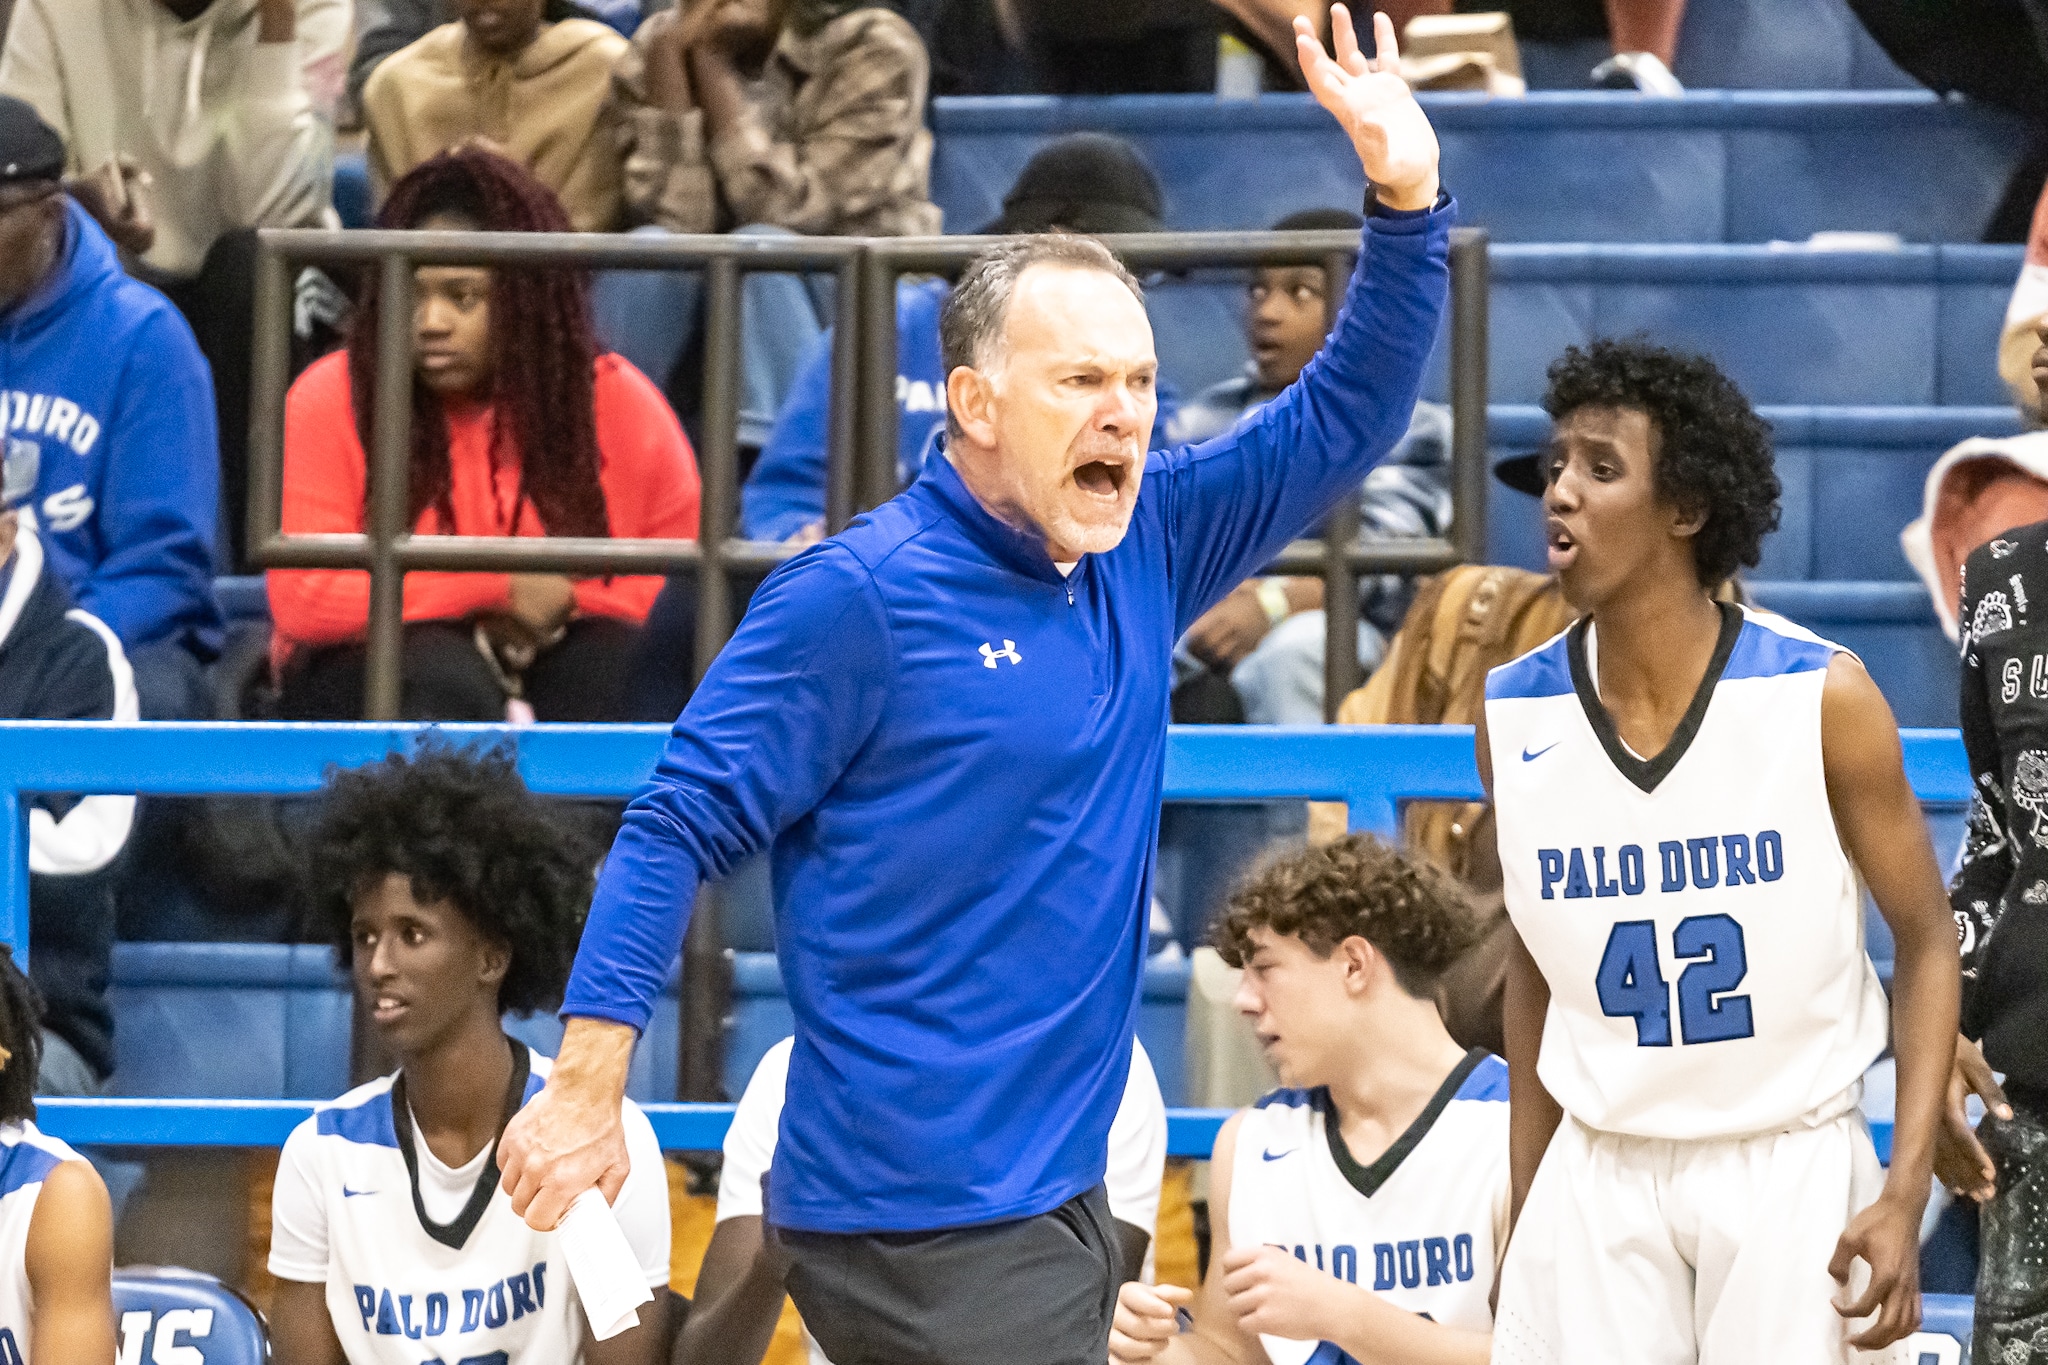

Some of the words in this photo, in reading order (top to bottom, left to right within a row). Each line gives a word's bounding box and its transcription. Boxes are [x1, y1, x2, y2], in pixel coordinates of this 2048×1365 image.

[1538, 844, 1645, 900] PALO
[1658, 830, 1784, 893] DURO
[1595, 913, 1755, 1047] 42
[1373, 1233, 1474, 1291] DURO
[354, 1283, 449, 1339] PALO
